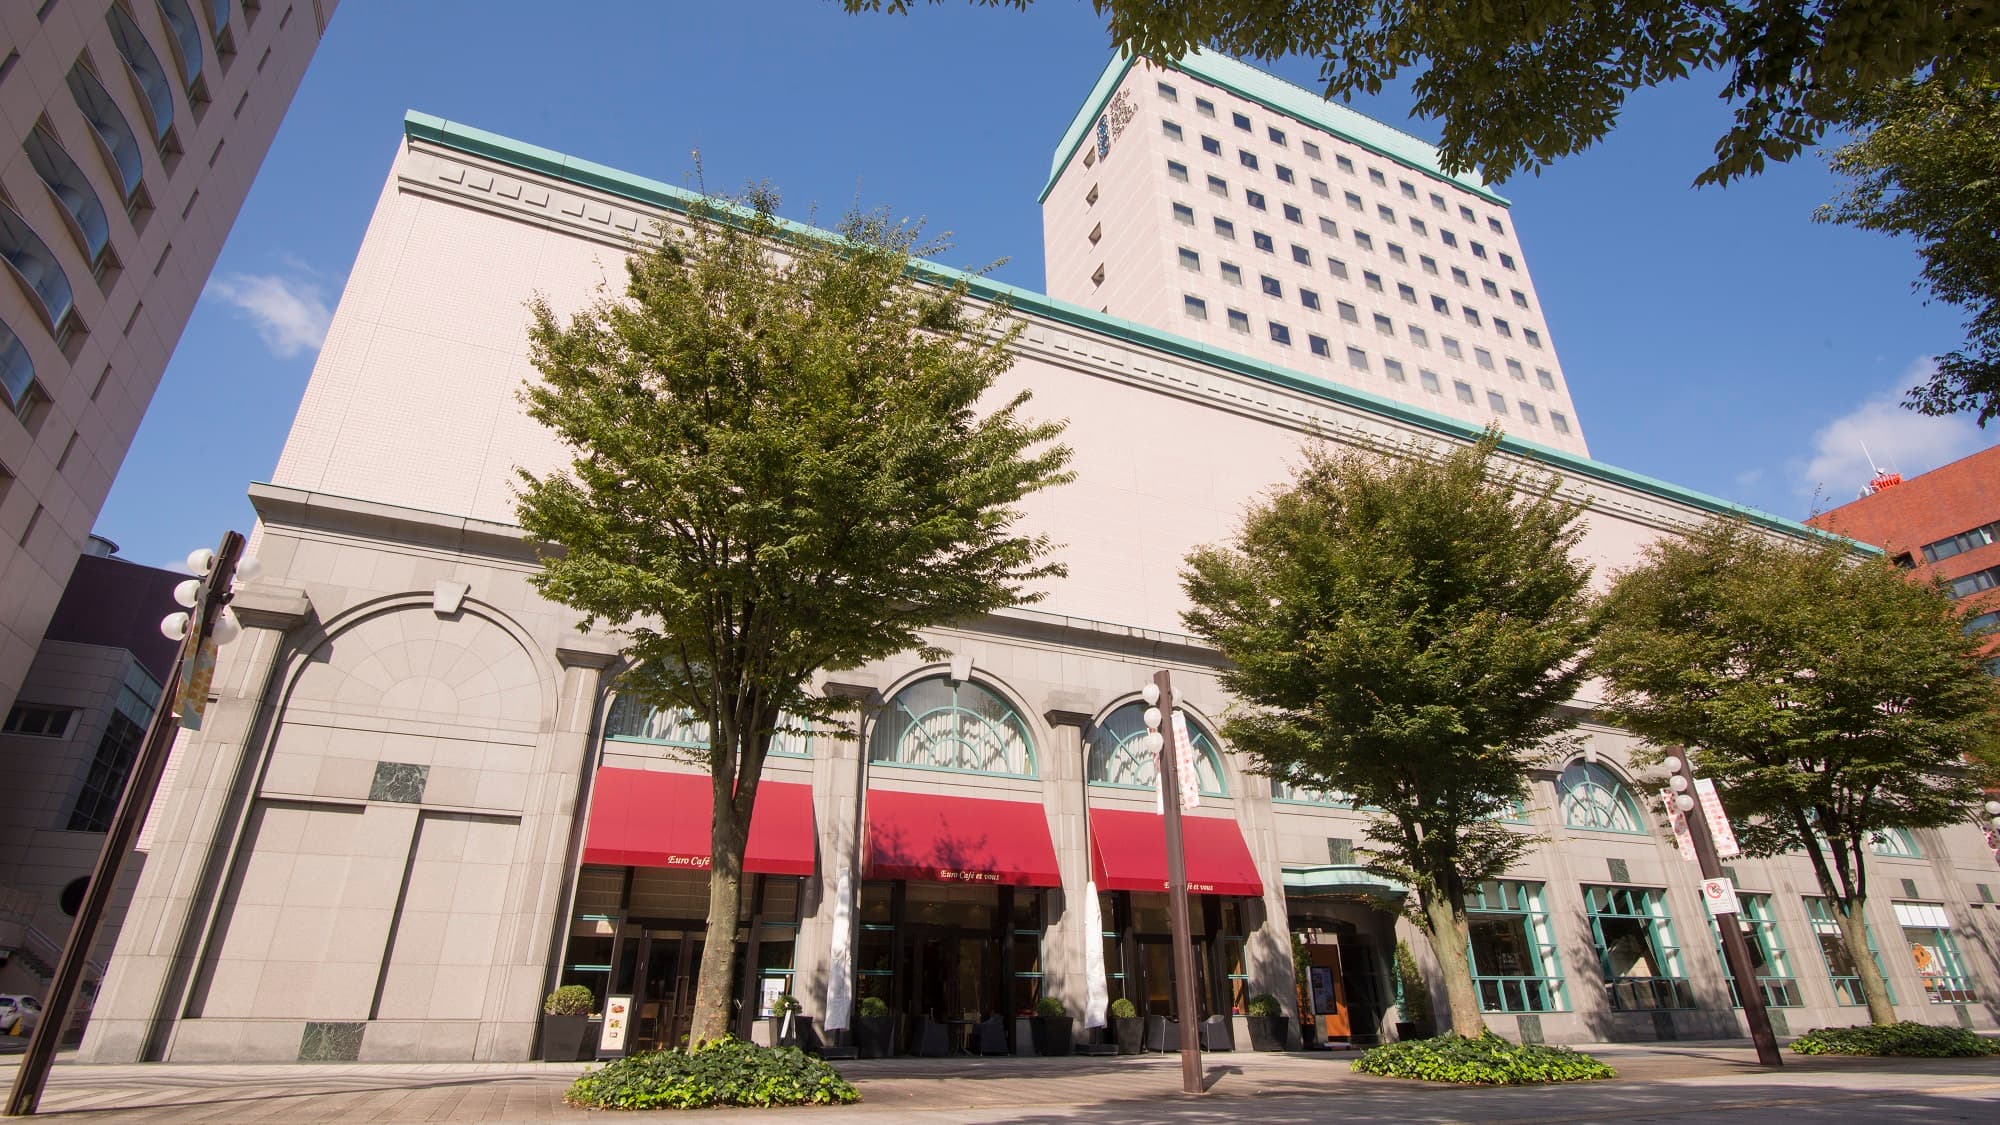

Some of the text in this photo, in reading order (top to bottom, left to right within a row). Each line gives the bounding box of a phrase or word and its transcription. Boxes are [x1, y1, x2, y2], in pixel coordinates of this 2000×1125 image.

[667, 855, 711, 868] Euro Café
[940, 869, 958, 879] Euro
